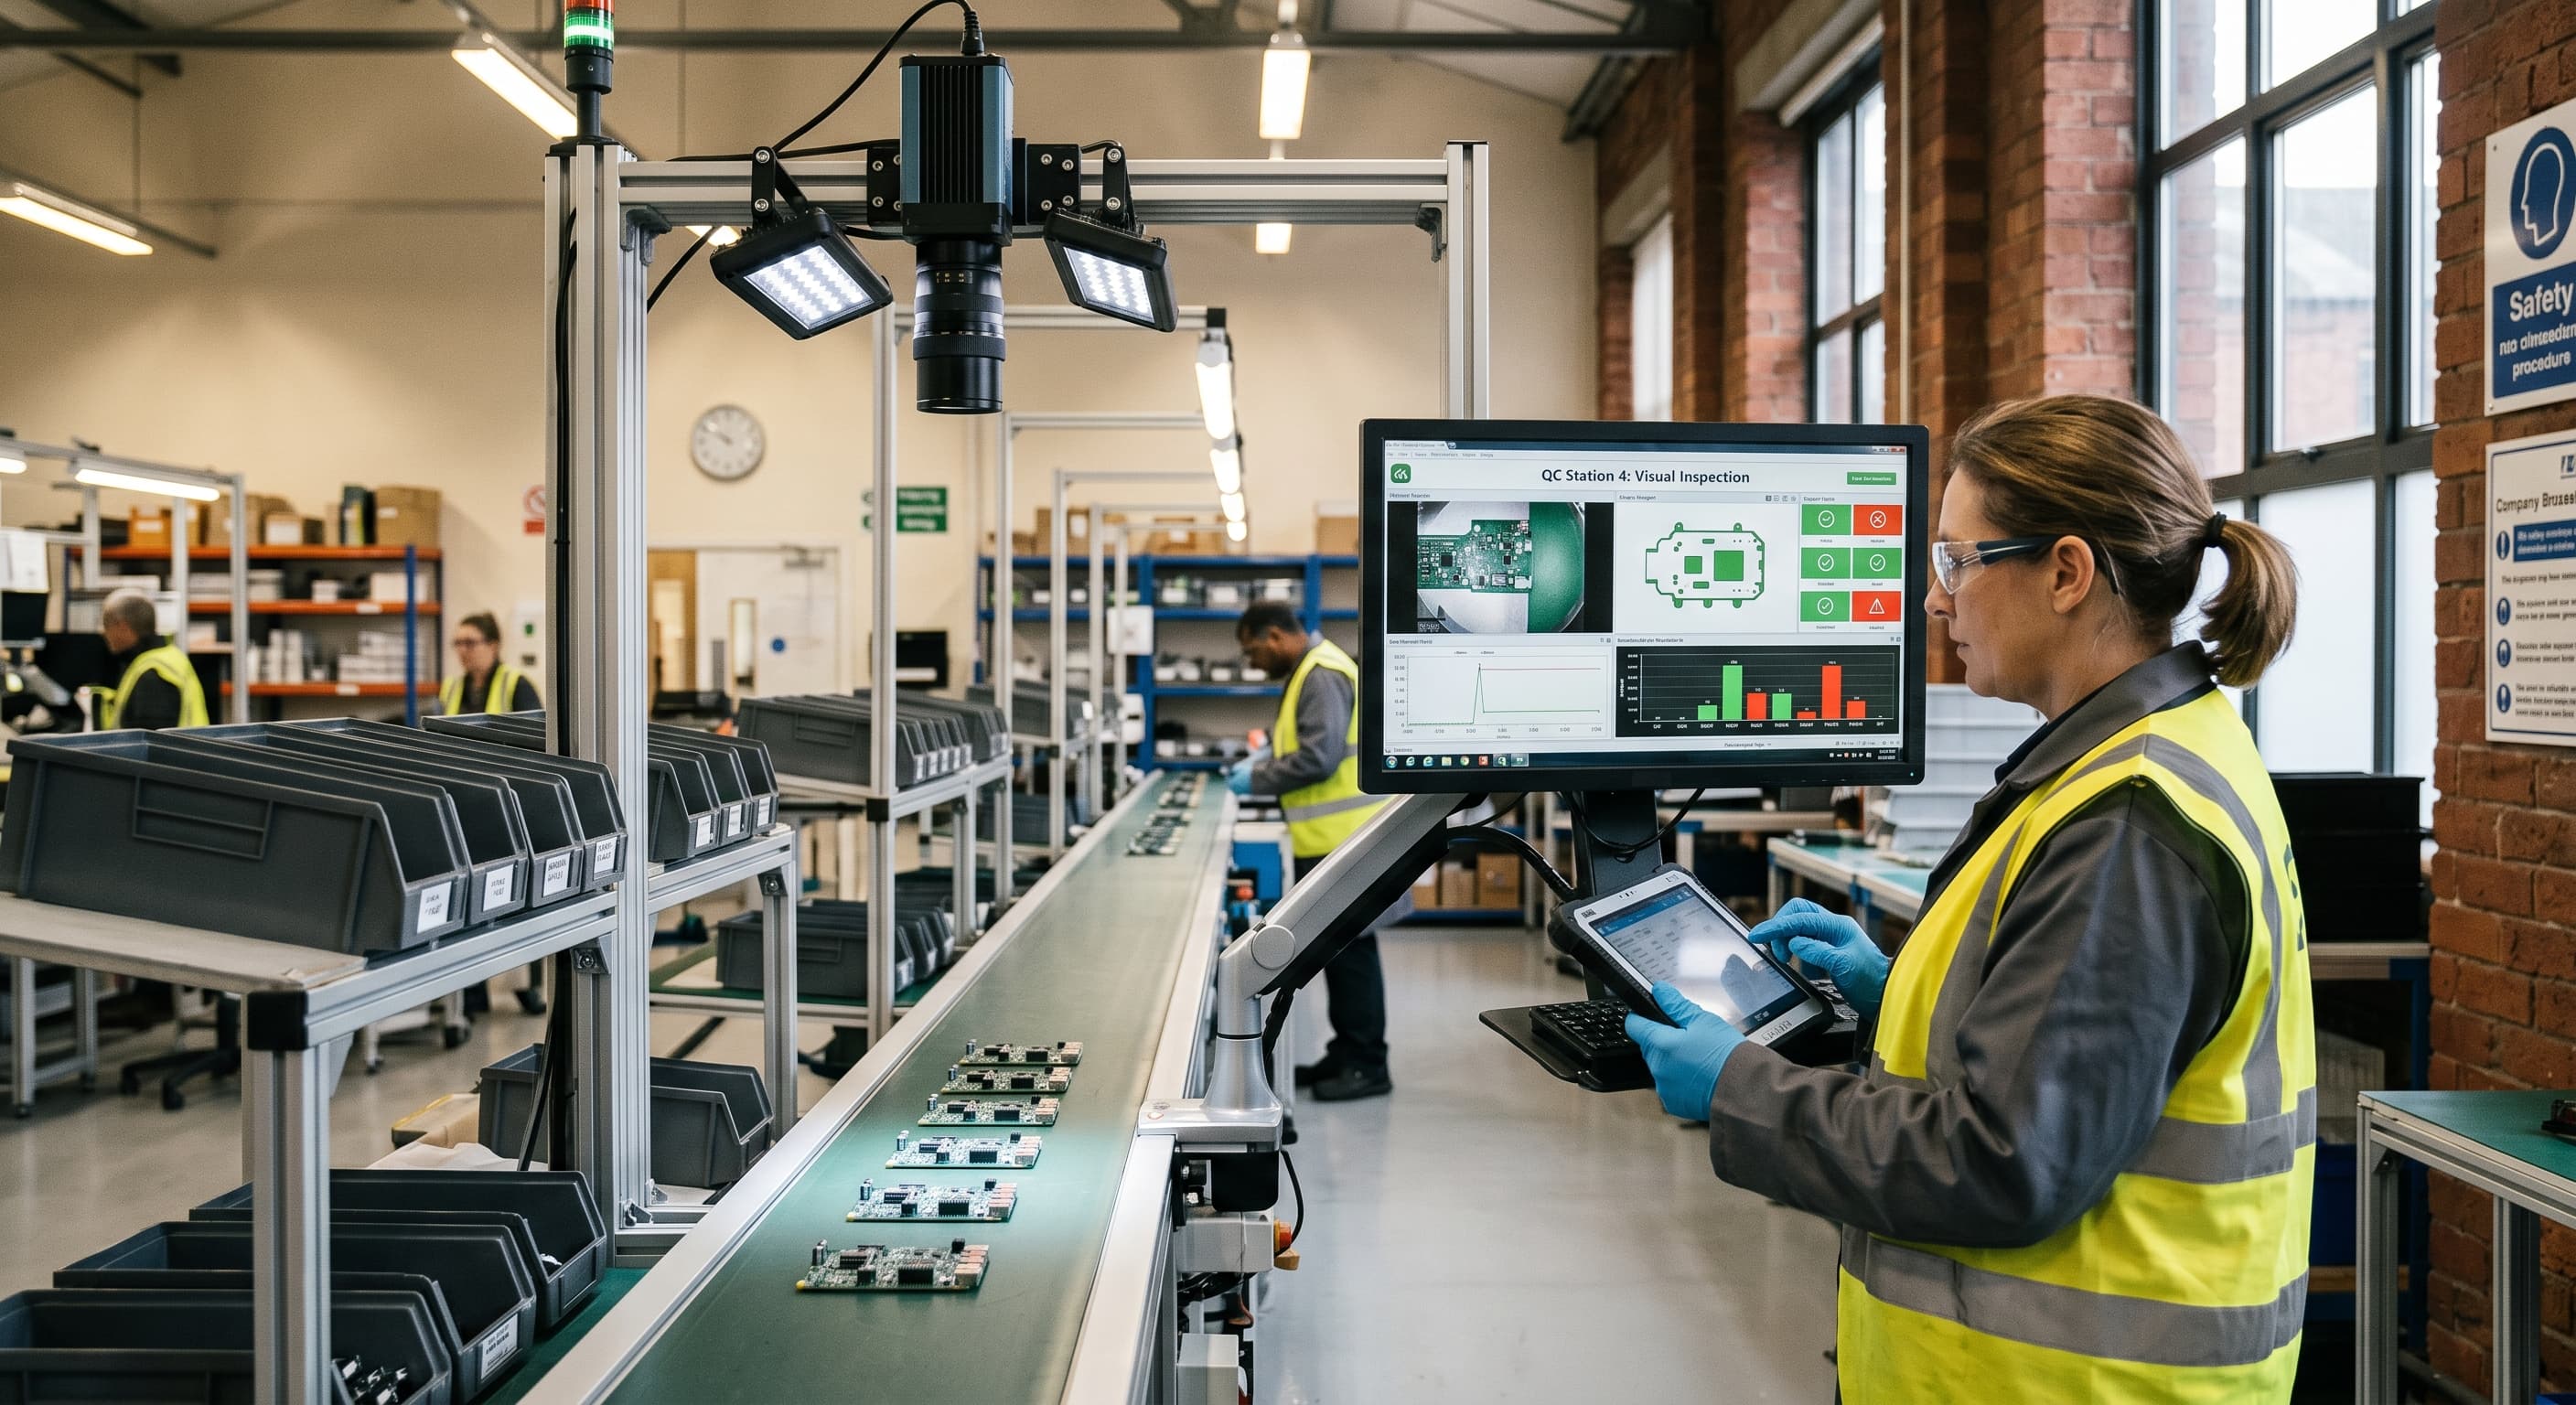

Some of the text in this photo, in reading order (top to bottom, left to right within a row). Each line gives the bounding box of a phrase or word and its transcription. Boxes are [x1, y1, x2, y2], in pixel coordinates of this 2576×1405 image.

[2509, 281, 2574, 322] Safety
[2512, 351, 2571, 381] procedure
[1541, 468, 1750, 486] QC Station 4: Visual Inspection
[2496, 498, 2539, 513] Company
